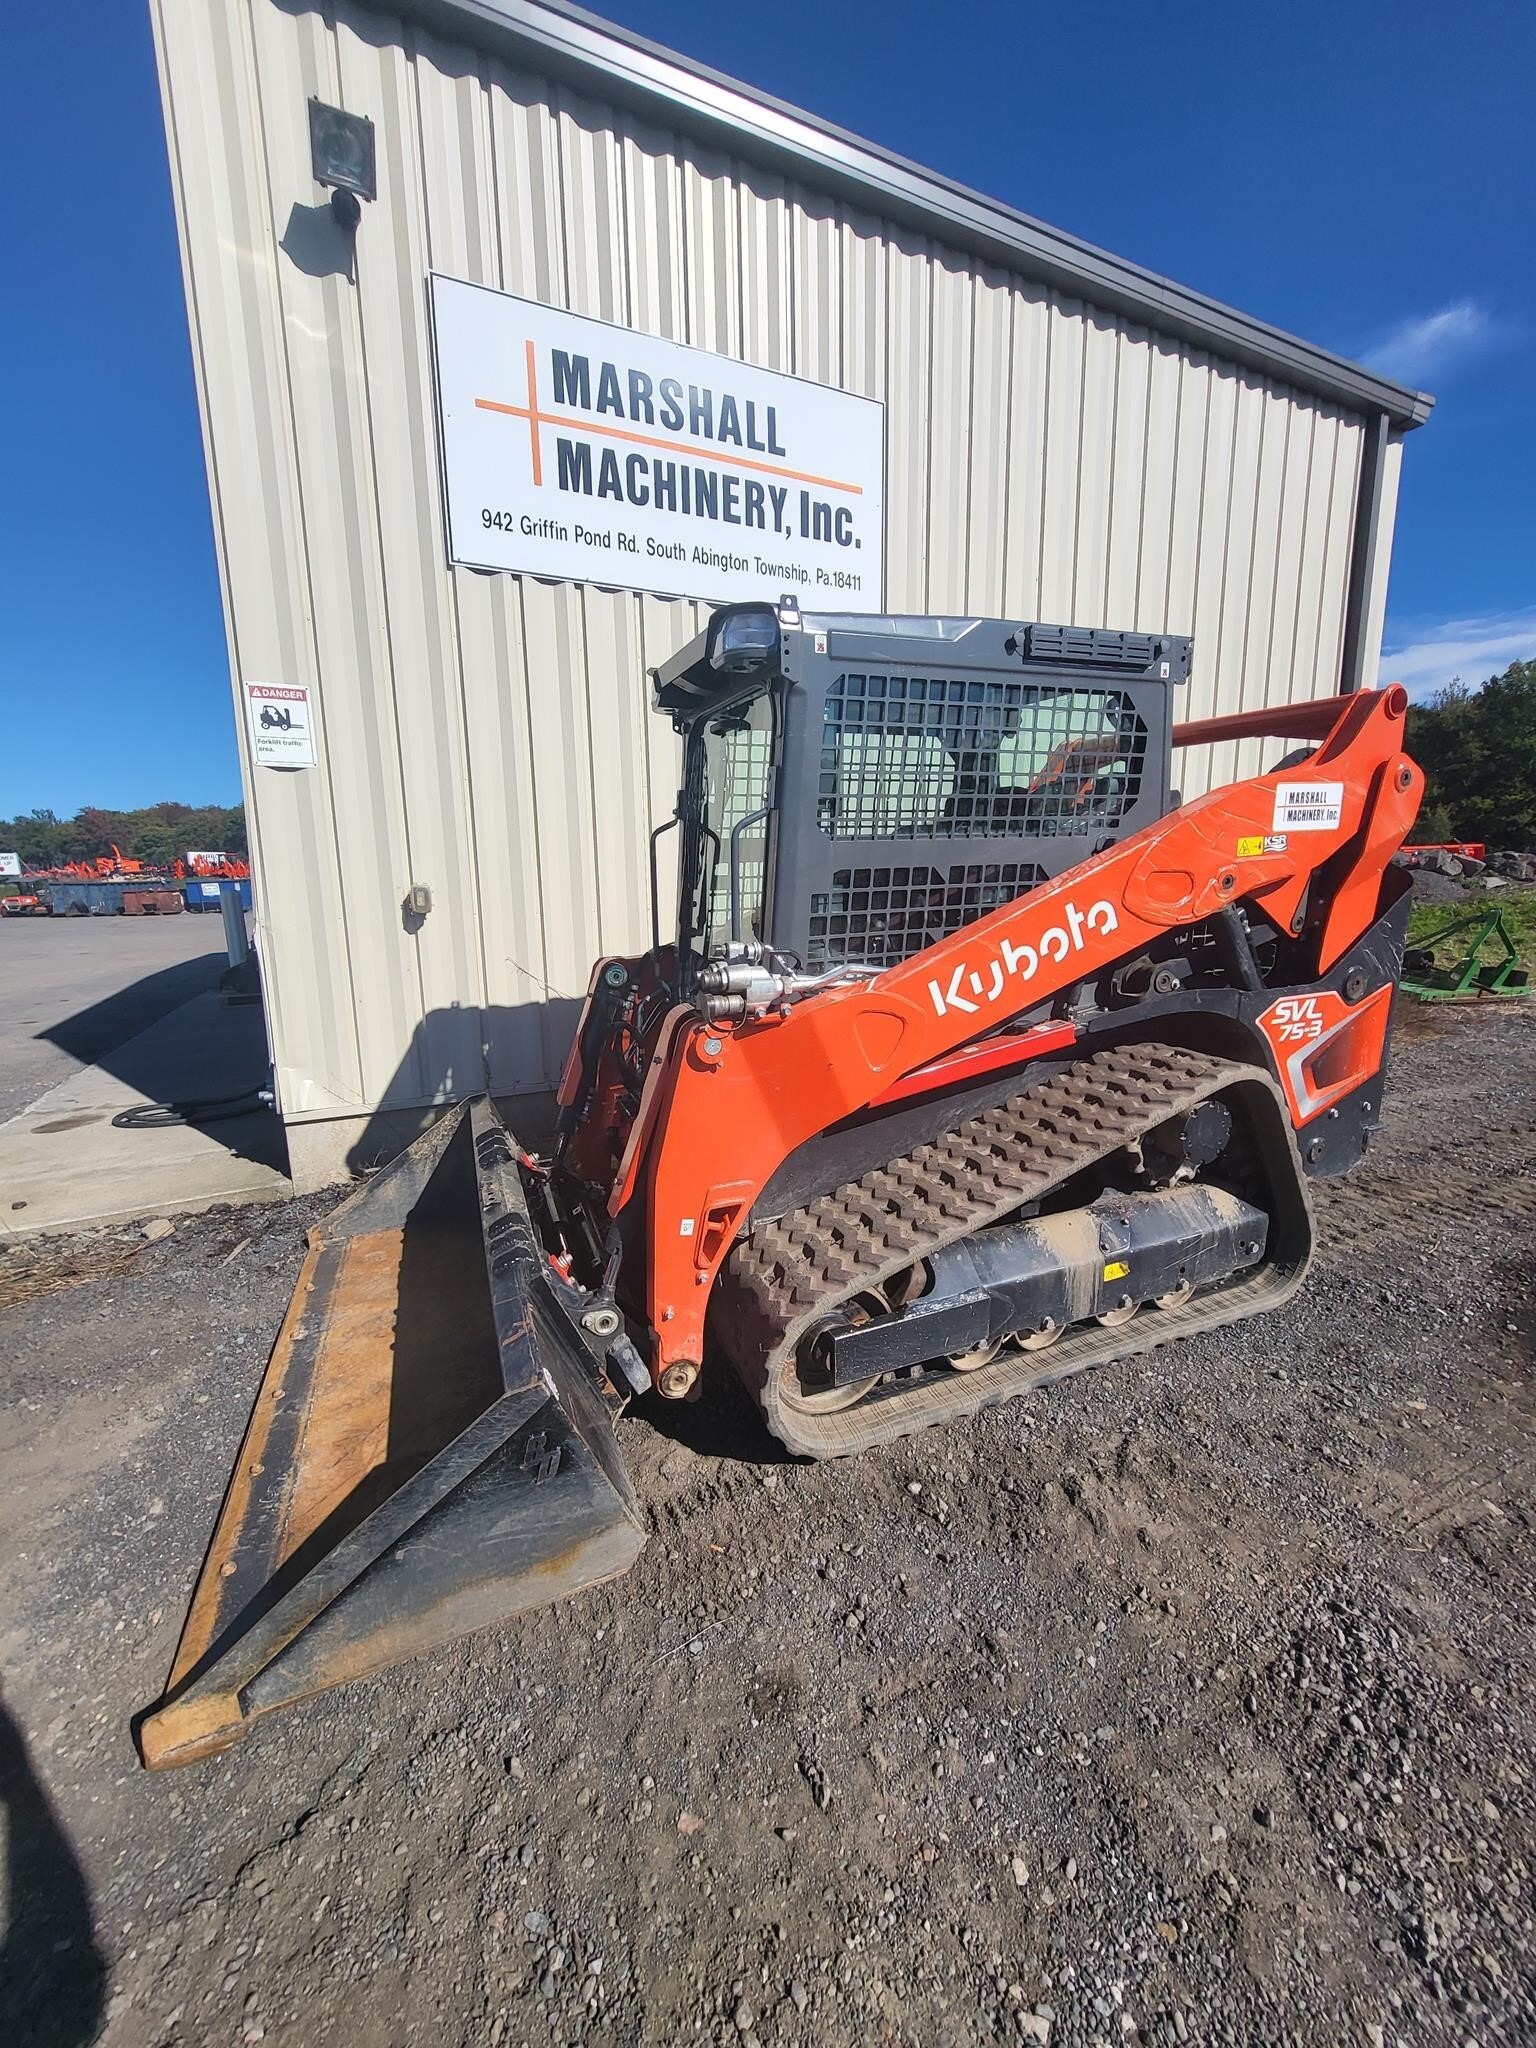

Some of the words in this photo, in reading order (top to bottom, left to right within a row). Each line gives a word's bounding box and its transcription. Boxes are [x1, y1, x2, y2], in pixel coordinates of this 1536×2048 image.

[551, 348, 786, 457] MARSHALL
[557, 437, 792, 541] MACHINERY,
[800, 490, 862, 549] Inc.
[481, 508, 514, 533] 942
[520, 515, 568, 541] Griffin
[574, 525, 611, 549] Pond
[617, 532, 640, 554] Rd.
[646, 537, 686, 561] South
[692, 546, 749, 572] Abington
[754, 556, 812, 585] Township,
[816, 567, 862, 591] Pa.18411
[262, 689, 303, 699] DANGER
[1289, 792, 1327, 804] MARSHALL
[1265, 835, 1286, 845] KSR
[927, 900, 1119, 1018] Kubota
[1271, 998, 1323, 1025] SVL
[1279, 1019, 1323, 1043] 75-3
